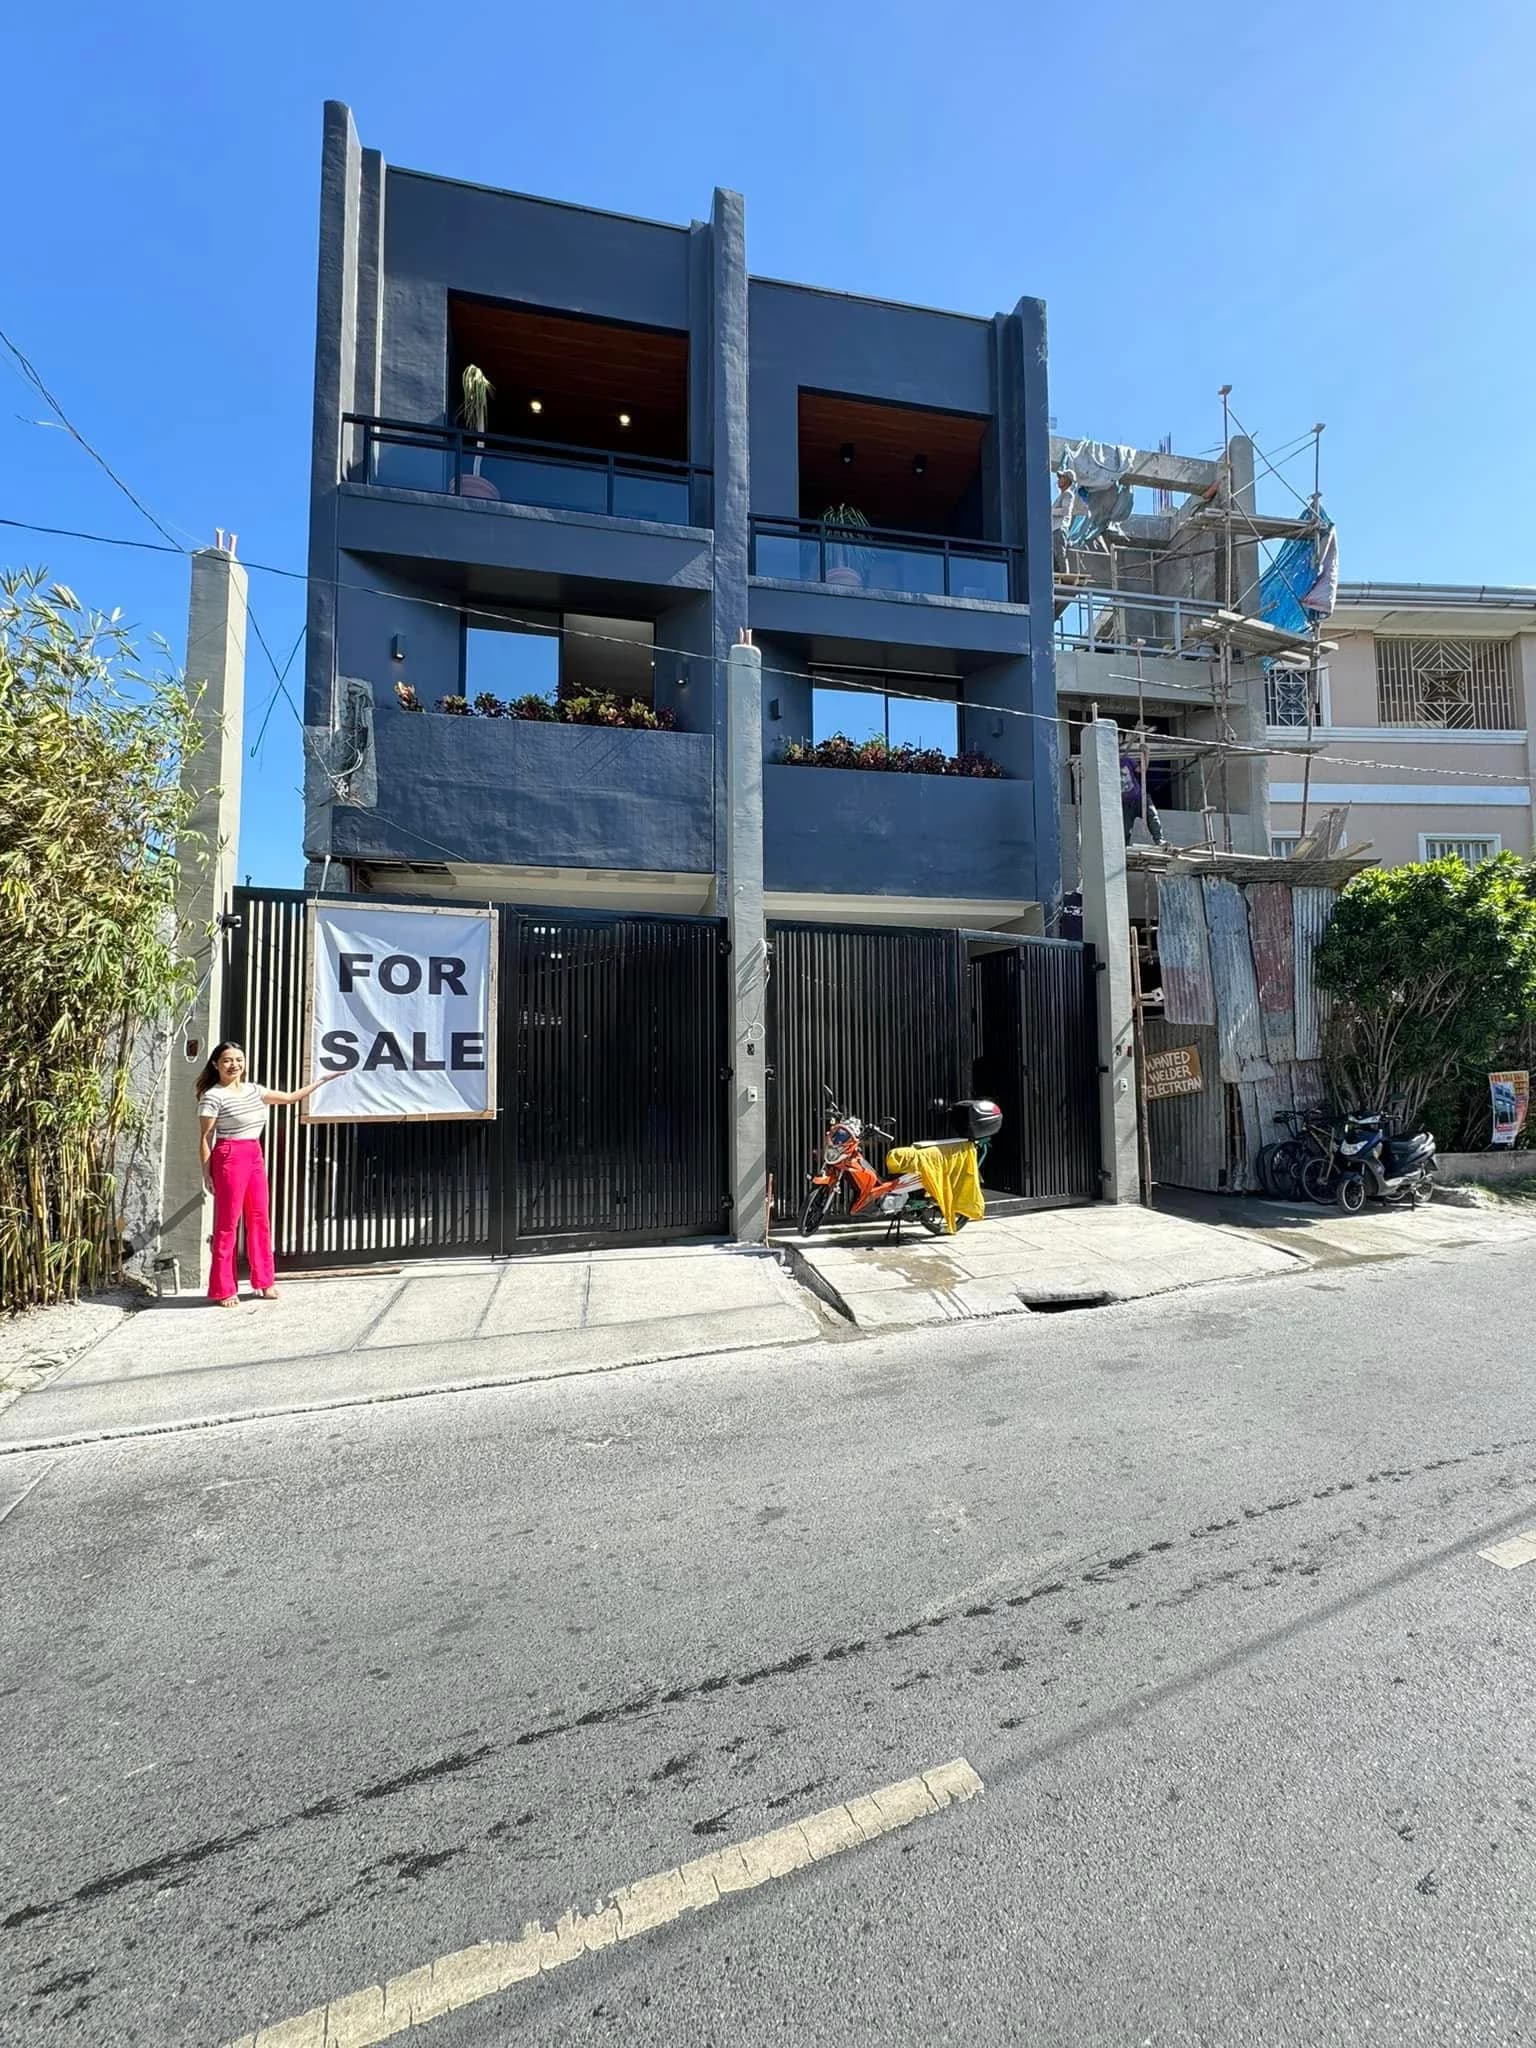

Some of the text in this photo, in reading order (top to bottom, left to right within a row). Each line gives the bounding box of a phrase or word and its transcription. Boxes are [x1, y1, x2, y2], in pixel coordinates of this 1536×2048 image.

[339, 952, 468, 995] FOR
[319, 1030, 485, 1071] SALE
[1145, 1051, 1190, 1071] WANTED
[1148, 1065, 1192, 1082] WELDER
